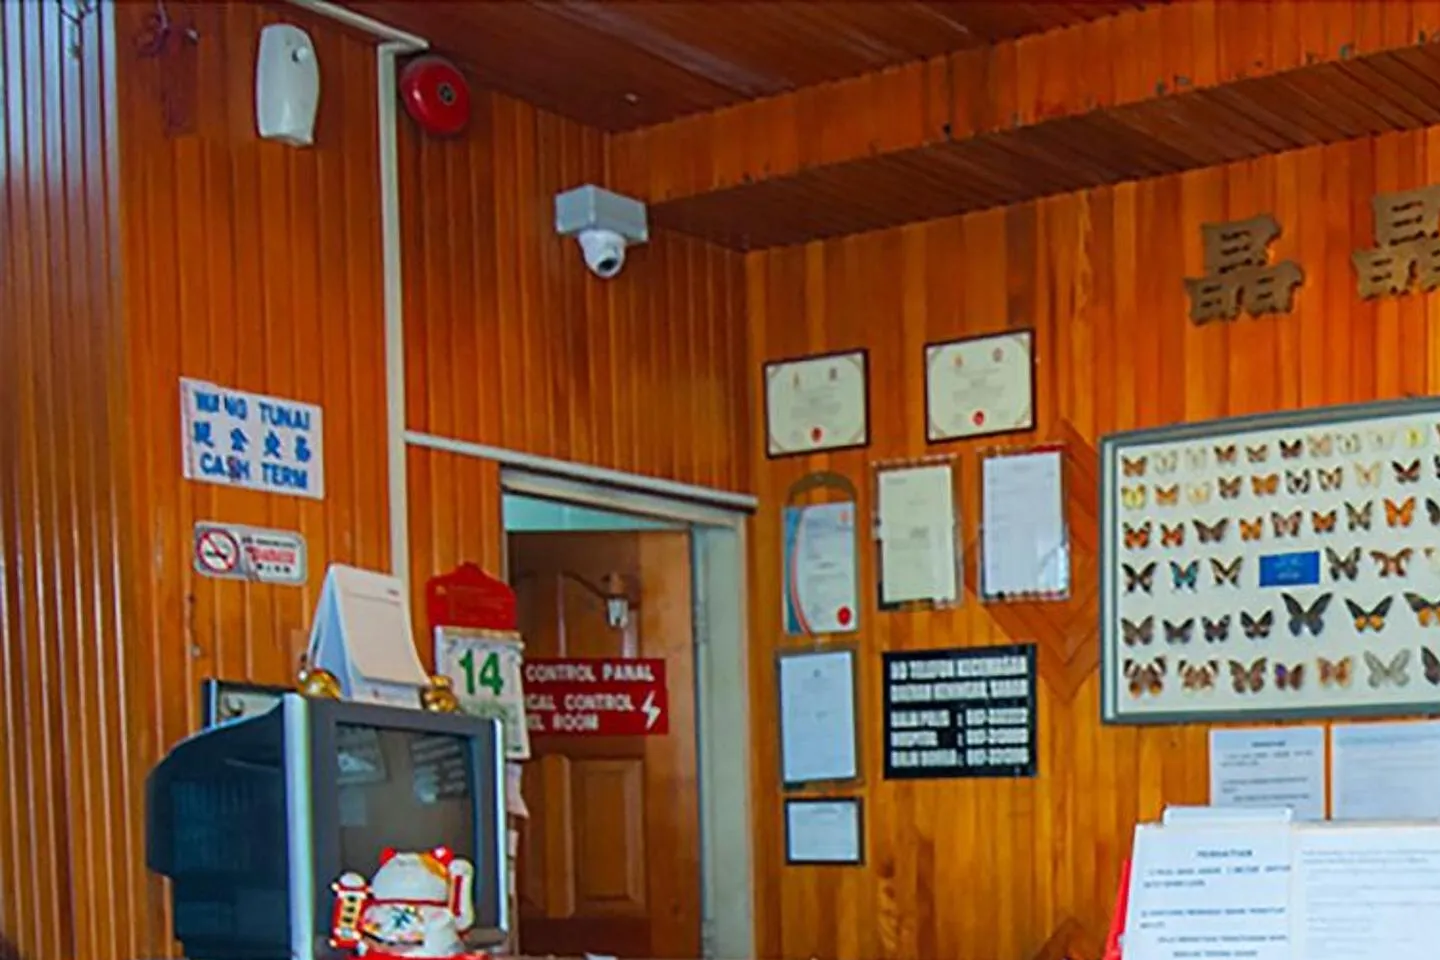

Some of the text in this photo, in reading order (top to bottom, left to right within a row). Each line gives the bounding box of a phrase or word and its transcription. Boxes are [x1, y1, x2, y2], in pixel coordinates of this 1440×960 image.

[259, 401, 311, 431] TUNAI
[200, 452, 308, 490] CASH TERM
[459, 649, 504, 696] 14
[525, 663, 597, 683] CONTROL
[563, 693, 636, 712] CONTROL
[552, 713, 599, 732] ROOM
